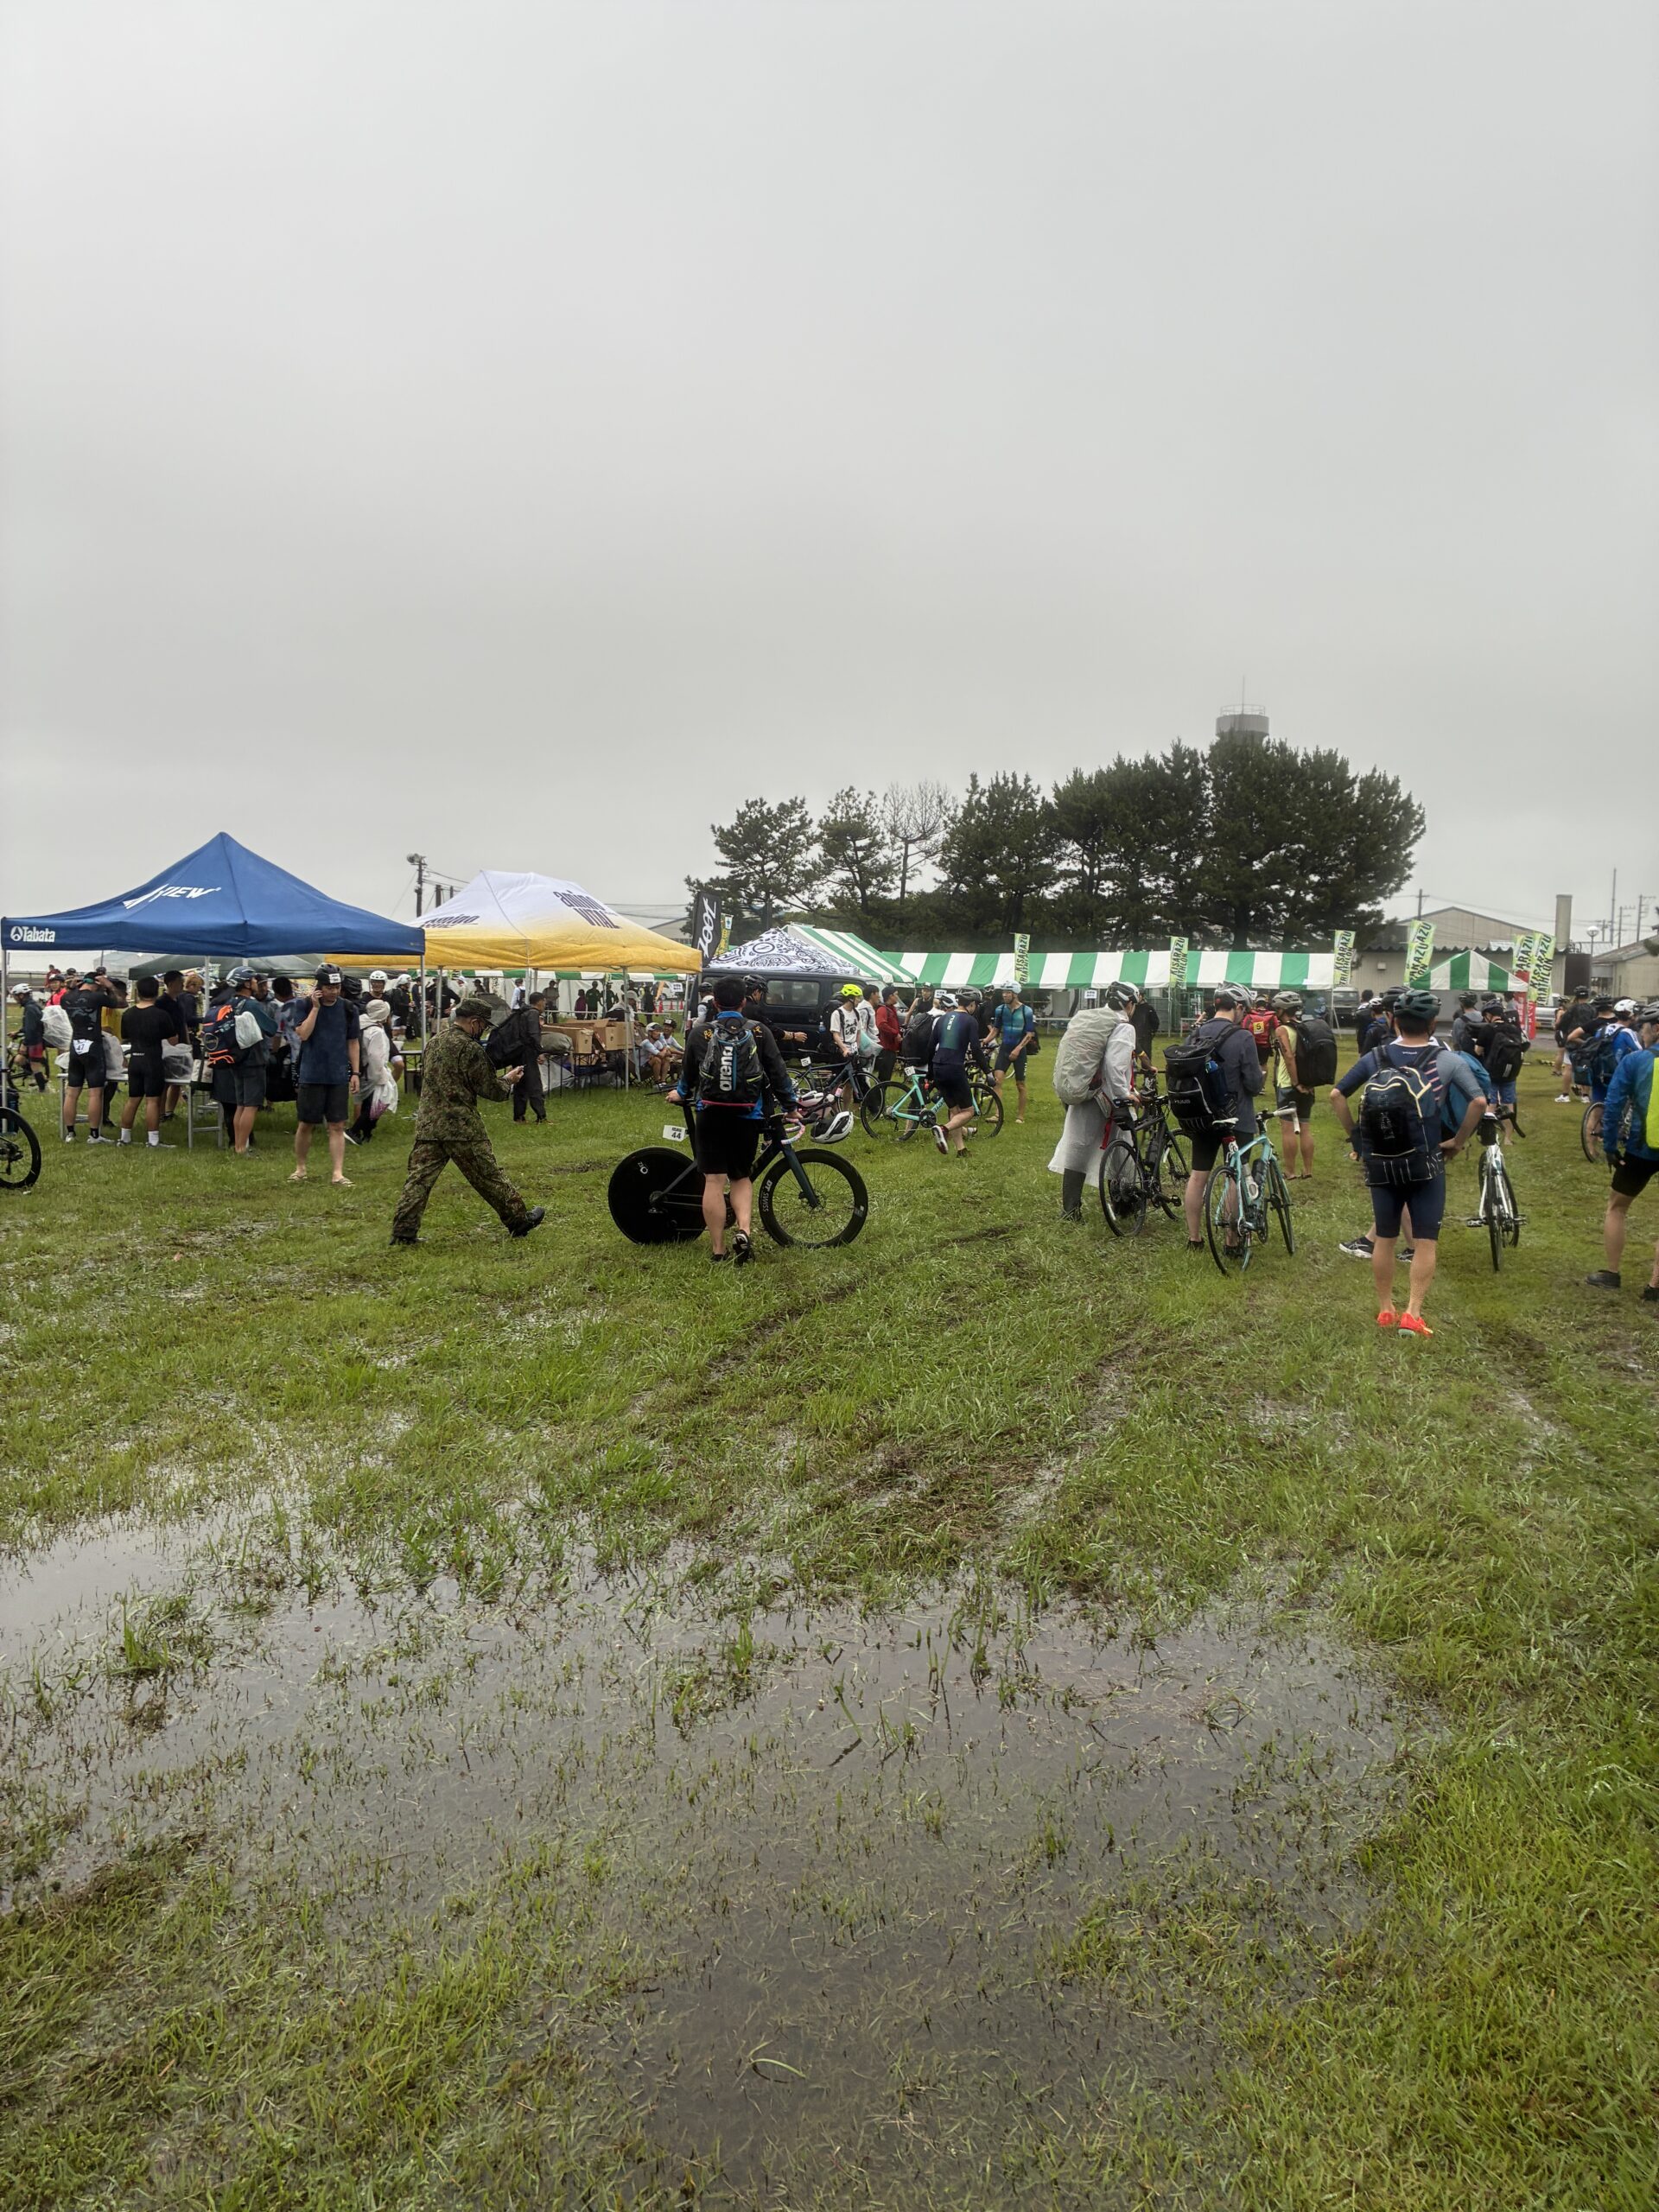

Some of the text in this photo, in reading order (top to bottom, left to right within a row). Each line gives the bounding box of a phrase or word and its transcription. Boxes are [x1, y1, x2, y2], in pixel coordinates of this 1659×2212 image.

[123, 883, 221, 909] VIEW
[22, 926, 55, 943] Tabata
[1015, 934, 1027, 972] KISARAZU
[1334, 931, 1351, 970] KISARAZU
[1170, 938, 1185, 976] KISARAZU
[1529, 934, 1552, 988] KISARAZU
[1537, 957, 1554, 1007] TRIATHLON
[720, 1046, 733, 1091] arena
[765, 1179, 773, 1192] DT
